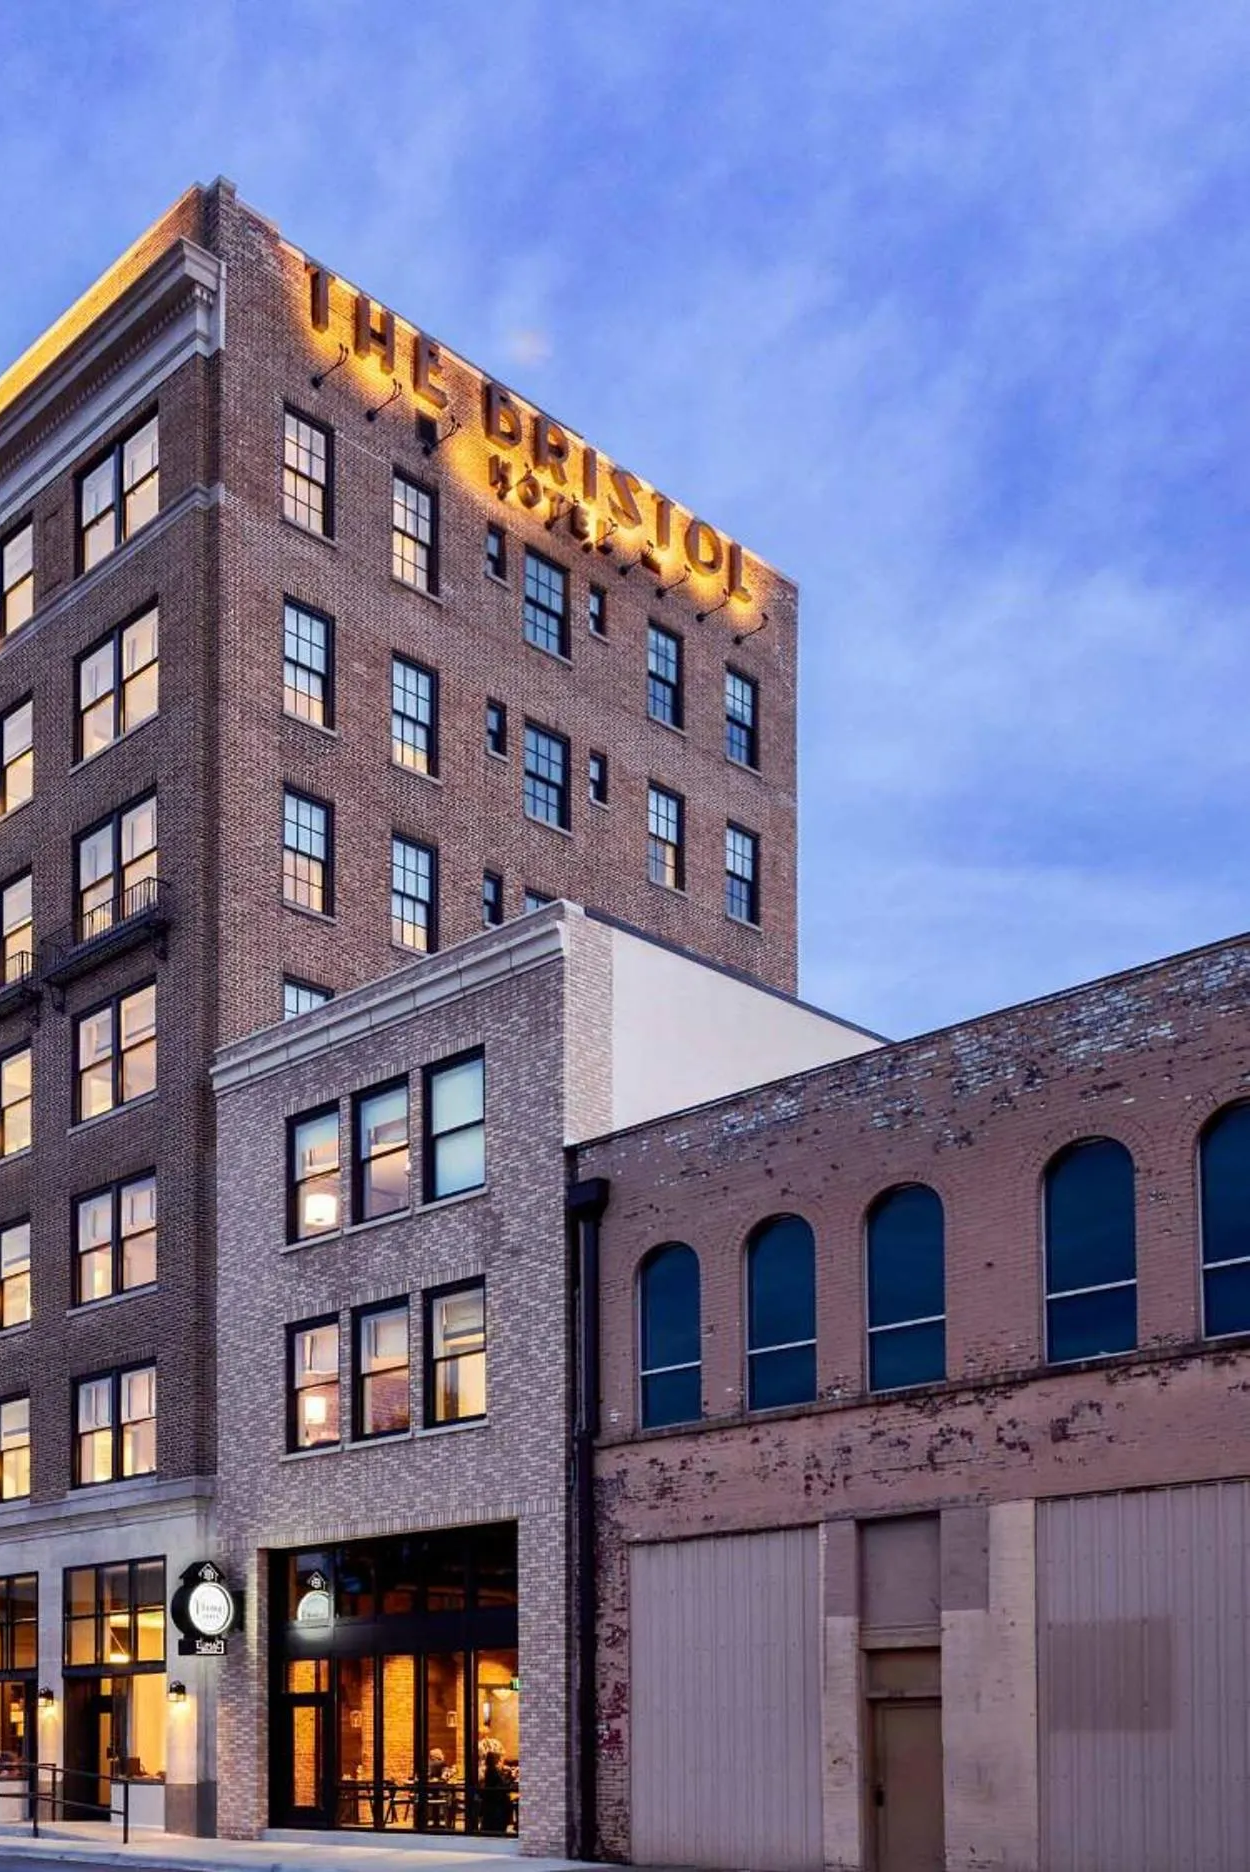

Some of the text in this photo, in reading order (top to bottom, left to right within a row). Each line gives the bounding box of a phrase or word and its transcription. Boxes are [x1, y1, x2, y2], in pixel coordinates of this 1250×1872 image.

[306, 261, 752, 602] THE BRISTOL
[488, 454, 614, 555] HOTEL
